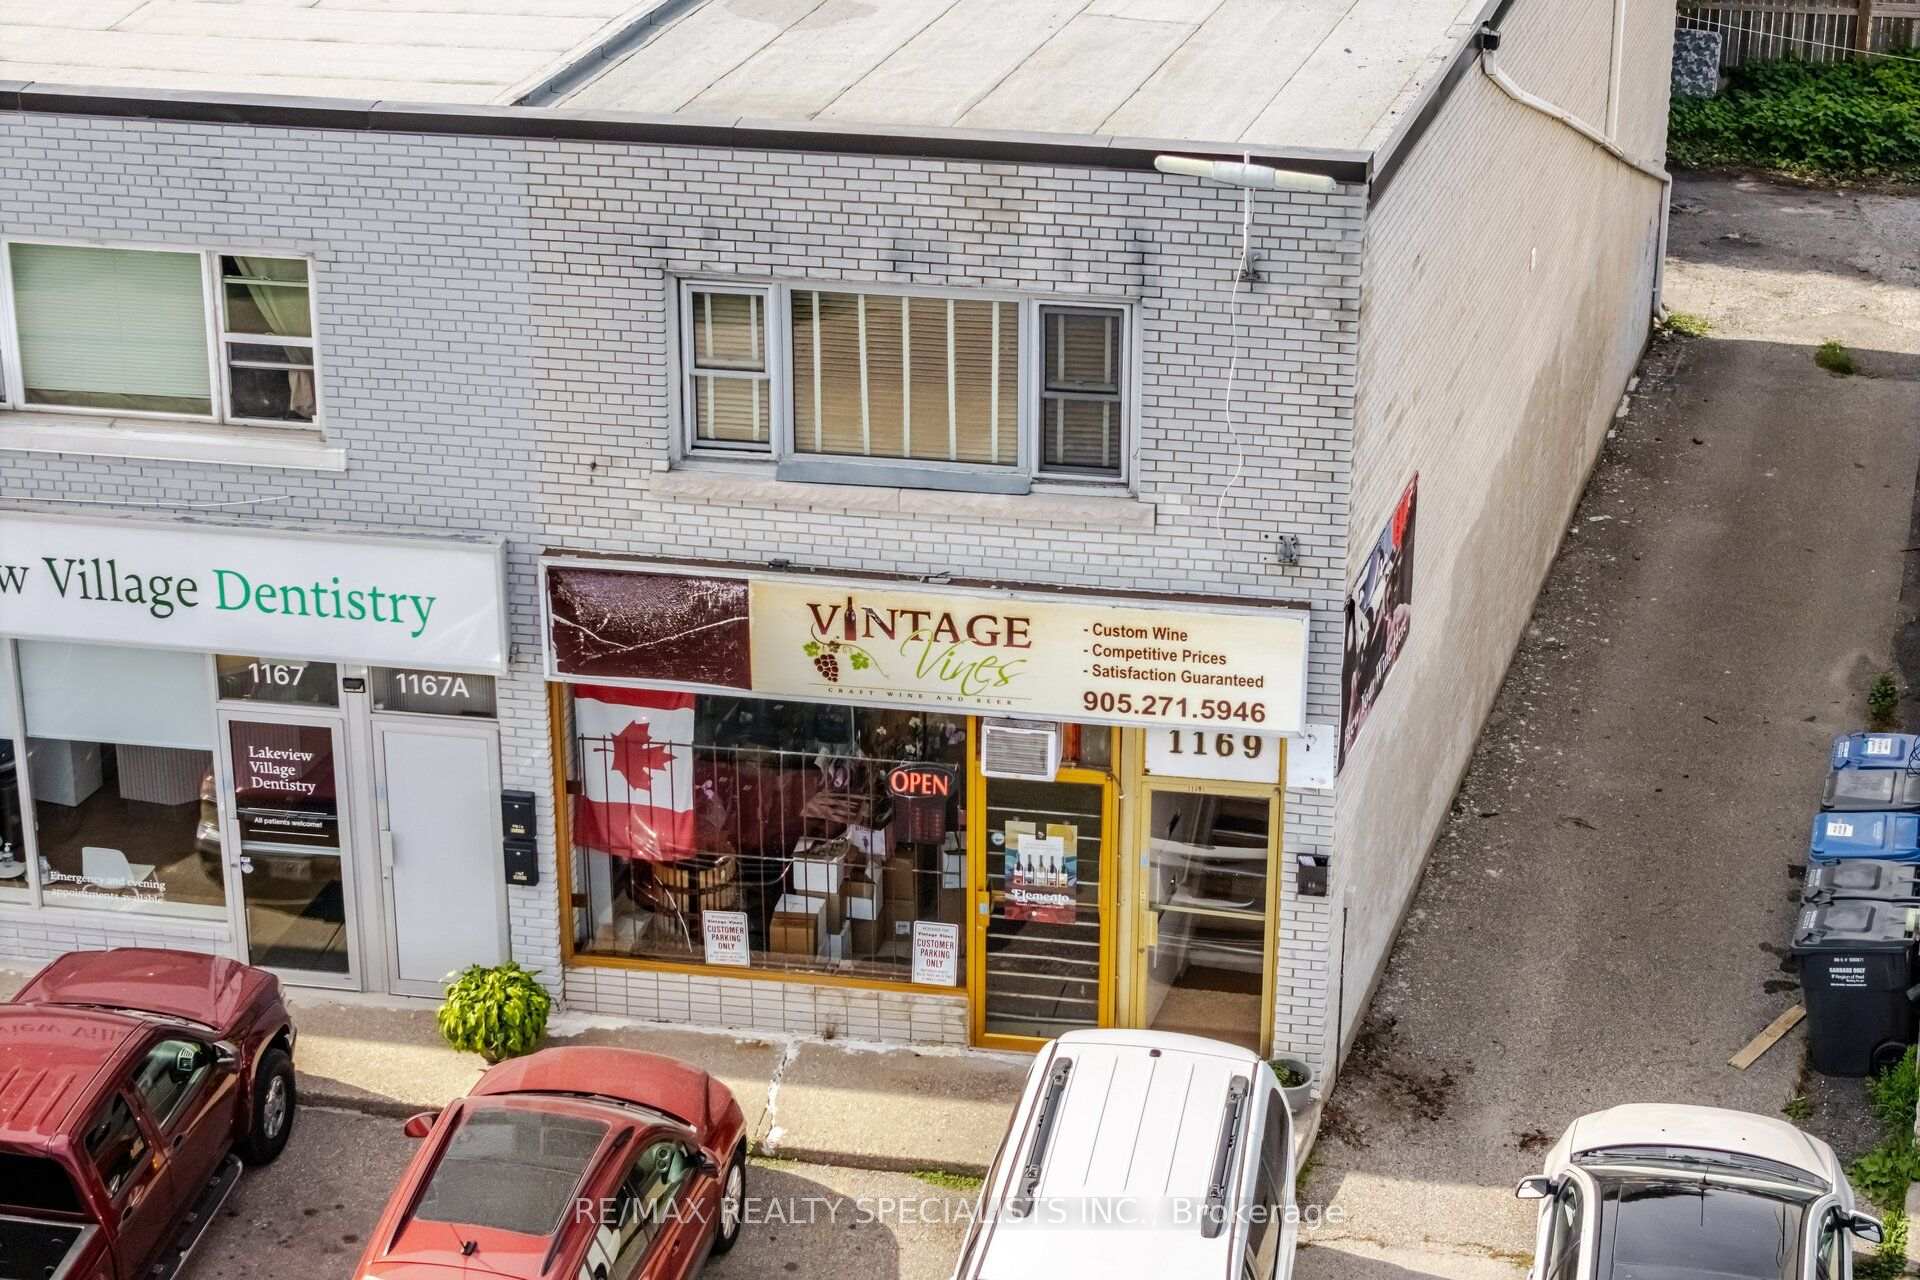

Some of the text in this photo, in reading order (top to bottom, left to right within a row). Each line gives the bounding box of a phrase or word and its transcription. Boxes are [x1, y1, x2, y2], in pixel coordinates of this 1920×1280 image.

[41, 557, 199, 619] Village
[212, 568, 437, 638] Dentistry
[806, 597, 1032, 649] VINTAGE
[1092, 623, 1148, 640] Custom
[1152, 626, 1188, 642] Wine
[900, 628, 1028, 697] Vines
[1092, 643, 1178, 663] Competitive
[1182, 649, 1227, 665] Prices
[248, 662, 305, 687] 1167
[1092, 664, 1176, 683] Satisfaction
[1181, 670, 1265, 689] Guaranteed
[396, 673, 470, 698] 1167A
[828, 687, 874, 696] CRAFT
[887, 691, 924, 699] WINE
[936, 694, 964, 702] AND
[1083, 690, 1266, 723] 905.271.5946
[1168, 729, 1263, 759] 1169
[248, 746, 313, 762] Lakeview
[249, 760, 296, 778] Village
[251, 776, 316, 795] Dentistry
[890, 770, 948, 796] OPEN
[254, 816, 323, 828] All patients welcome!
[127, 878, 166, 893] evening
[707, 925, 745, 935] CUSTOMER
[711, 933, 742, 943] PARKING
[718, 942, 736, 951] ONLY
[916, 938, 954, 950] CUSTOMER
[920, 948, 950, 959] PARKING
[926, 958, 944, 969] ONLY
